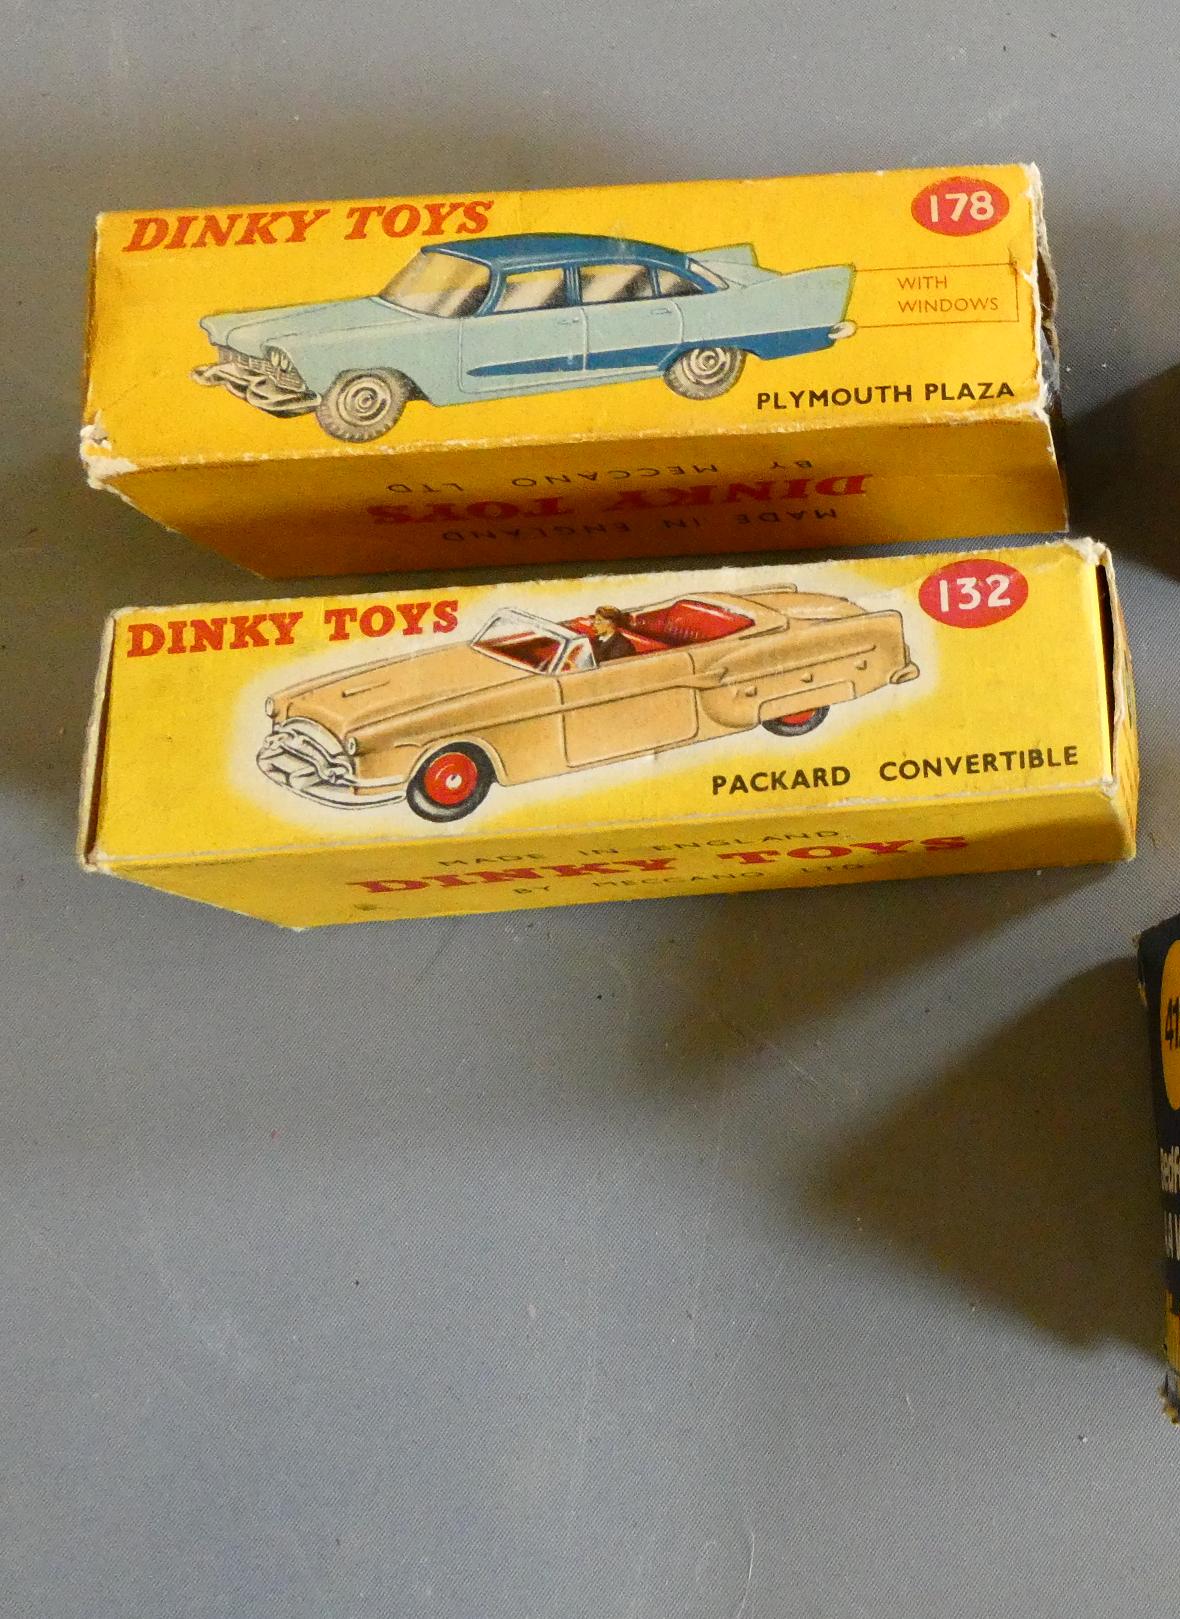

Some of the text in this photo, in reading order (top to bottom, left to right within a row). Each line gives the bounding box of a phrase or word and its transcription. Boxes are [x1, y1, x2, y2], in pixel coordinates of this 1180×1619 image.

[929, 190, 995, 222] 178
[122, 200, 495, 253] DINKY TOYS
[896, 276, 948, 291] WITH
[897, 297, 999, 314] WINDOWS
[756, 382, 1015, 411] PLYMOUTH PLAZA
[512, 463, 719, 488] MECCANO
[770, 459, 813, 471] BY
[601, 474, 873, 513] DINKY
[736, 508, 838, 524] MADE
[939, 574, 1012, 612] 132
[126, 600, 459, 658] DINKY TOYS
[712, 745, 1079, 796] PACKARD CONVERTIBLE
[345, 835, 969, 893] DINKY TOYS
[437, 854, 546, 867] MADE
